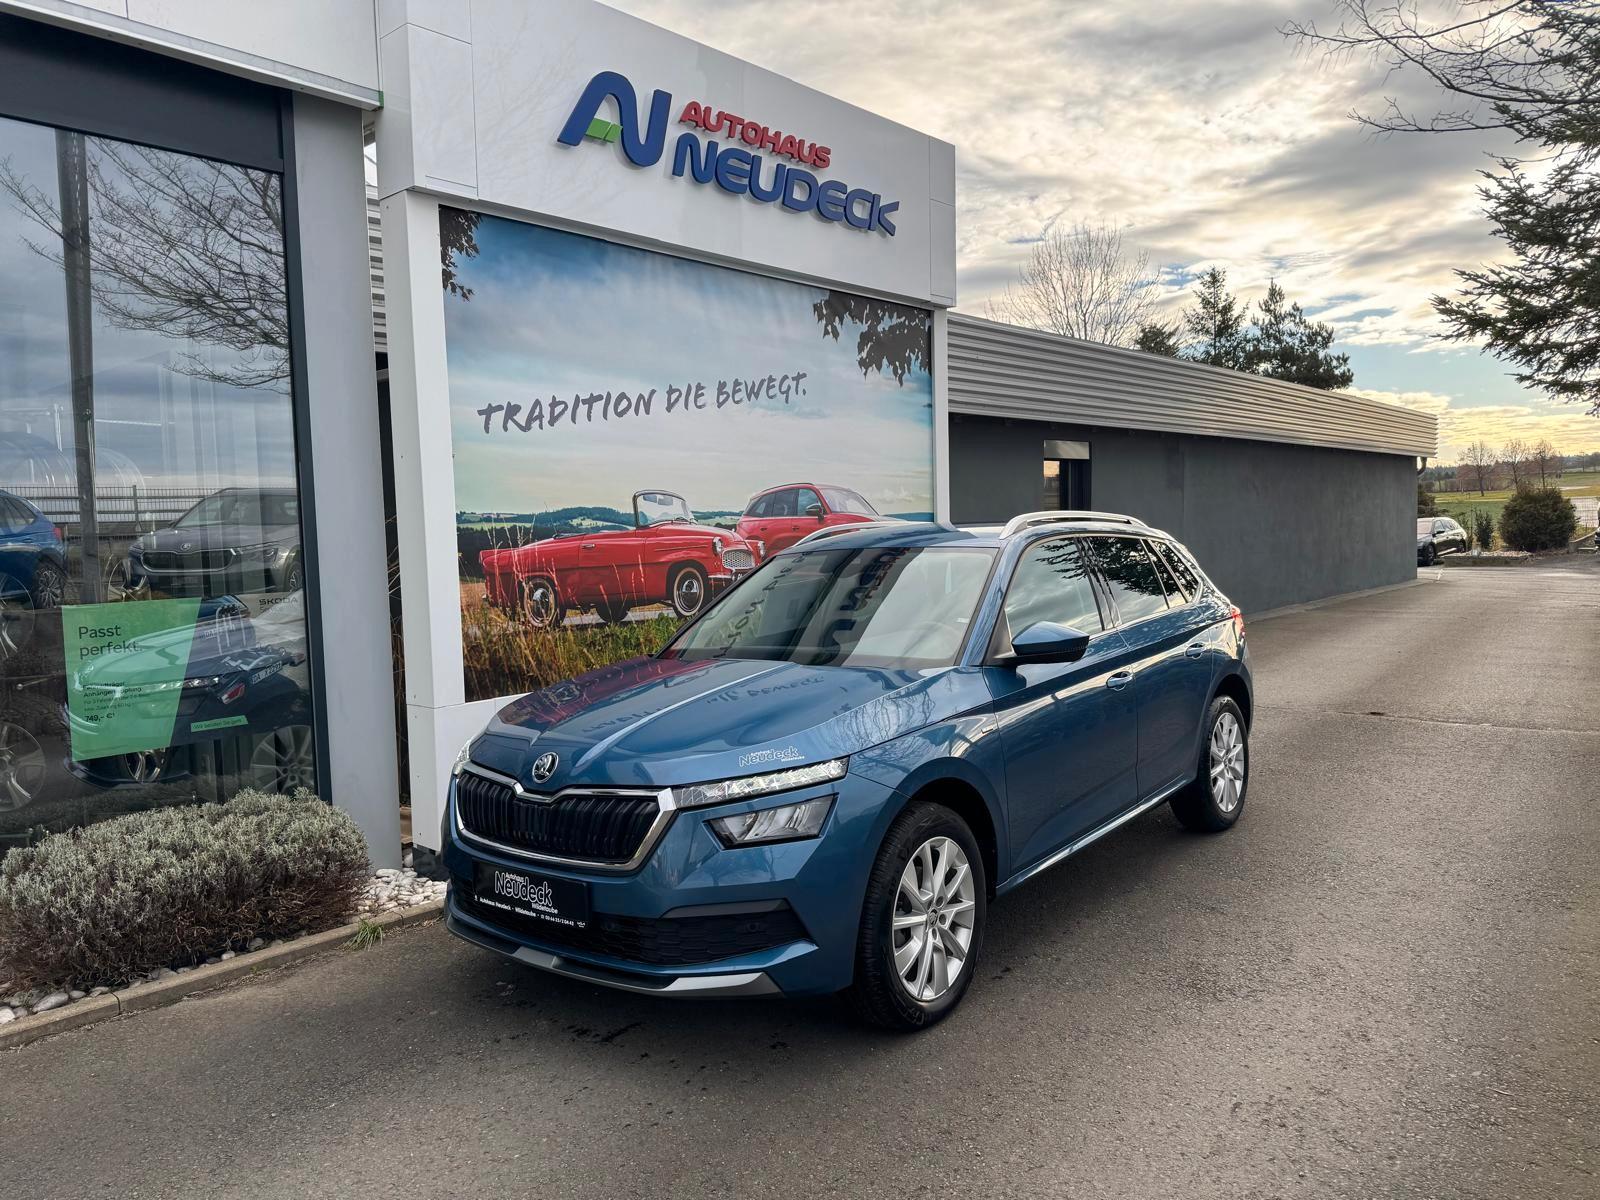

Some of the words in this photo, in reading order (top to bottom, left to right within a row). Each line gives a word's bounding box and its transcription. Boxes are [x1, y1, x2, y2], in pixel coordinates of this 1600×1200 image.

[679, 100, 832, 169] AUTOHAUS
[671, 132, 900, 237] NEUDECK
[477, 388, 657, 434] TRADITION
[665, 381, 707, 413] DIE
[715, 371, 807, 408] BEWEGT.
[78, 625, 122, 639] Passt
[738, 746, 799, 768] Neudeck
[494, 870, 552, 906] Neudeck
